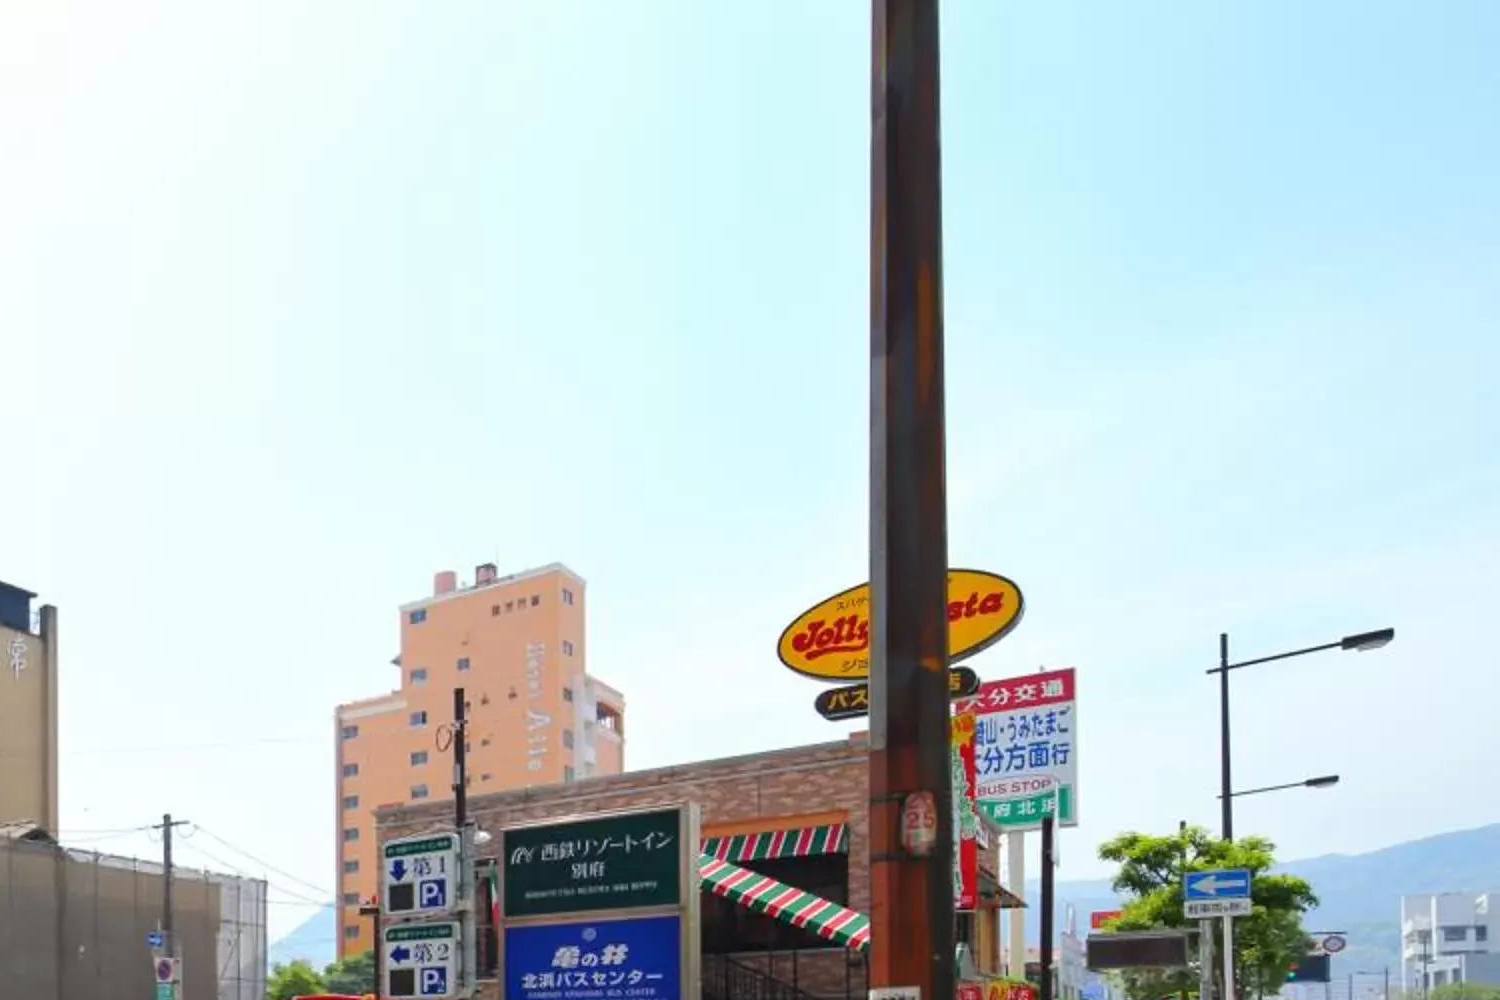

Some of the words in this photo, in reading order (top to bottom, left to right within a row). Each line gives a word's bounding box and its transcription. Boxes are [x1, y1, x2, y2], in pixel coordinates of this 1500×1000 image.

[975, 706, 1072, 747] 崎山・うみたまご
[975, 741, 1071, 775] 分方面行
[977, 782, 1008, 796] BUS
[1011, 779, 1052, 793] STOP
[983, 796, 1058, 818] 府北浜
[540, 831, 674, 861] 西鉄リゾートイン
[571, 861, 606, 880] 別府
[551, 943, 629, 968] 亀の井
[521, 969, 664, 989] 北浜バスセンター
